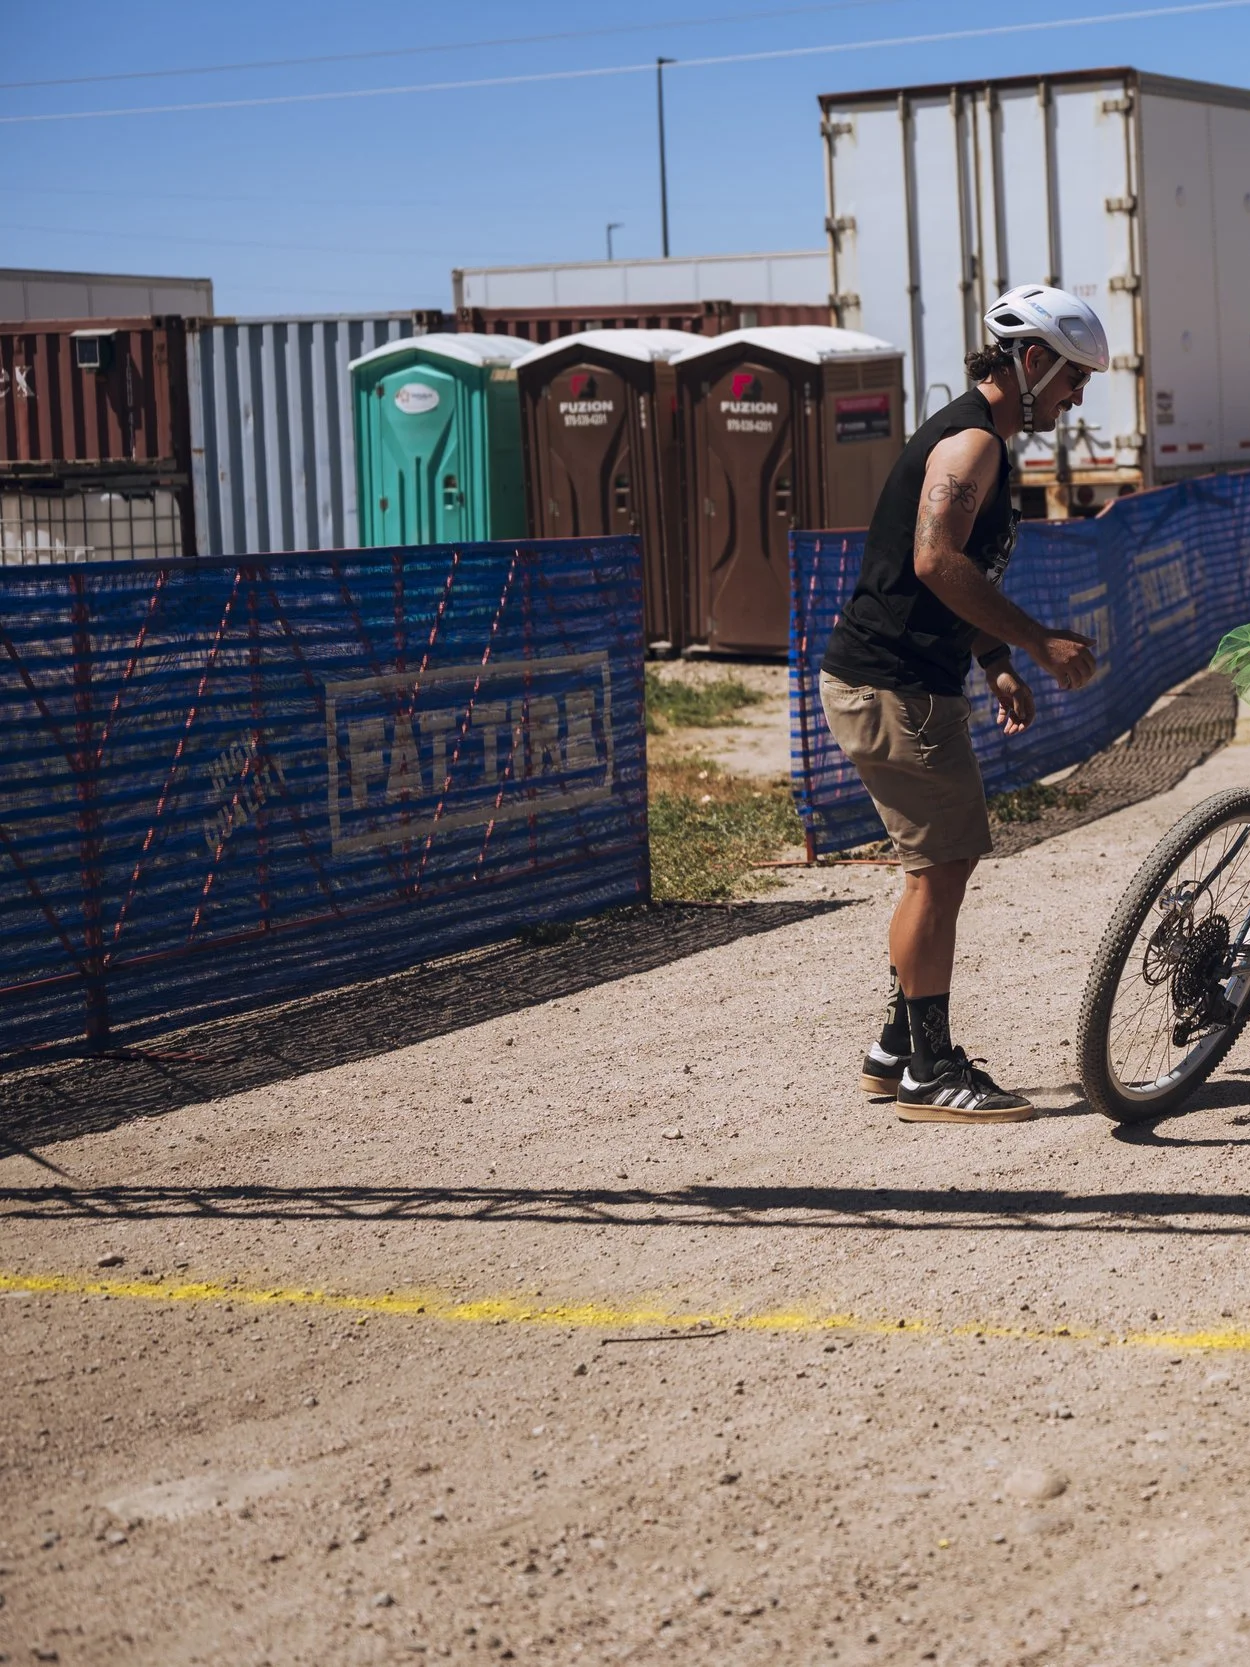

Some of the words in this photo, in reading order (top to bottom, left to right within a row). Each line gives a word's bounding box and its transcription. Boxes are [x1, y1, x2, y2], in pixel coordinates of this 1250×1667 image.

[560, 400, 613, 414] FUZION
[721, 401, 778, 414] FUZION
[347, 707, 457, 809] FAT
[470, 689, 599, 784] TIRE
